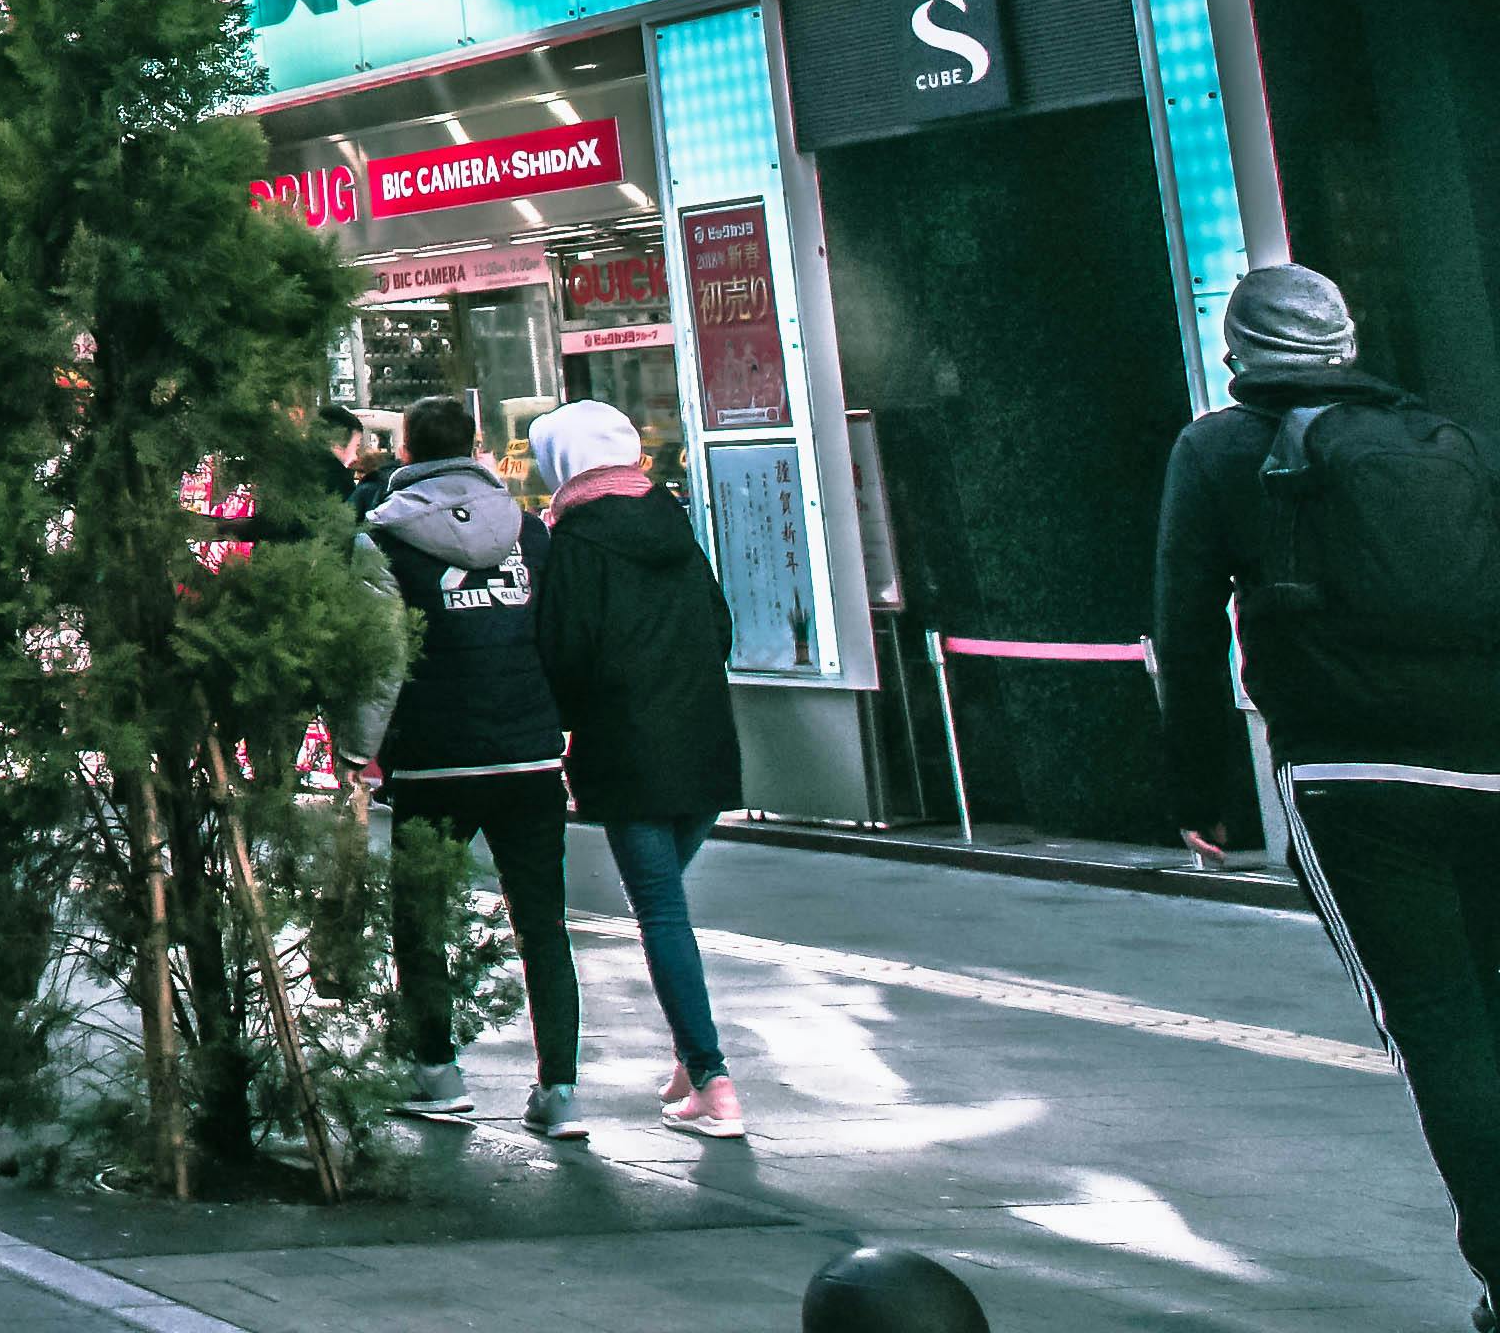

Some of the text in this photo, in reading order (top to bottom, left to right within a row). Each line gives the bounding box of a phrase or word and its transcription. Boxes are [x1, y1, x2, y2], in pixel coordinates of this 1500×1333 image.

[915, 67, 964, 90] CUBE
[381, 170, 414, 201] BIC
[416, 155, 501, 195] CAMERA
[511, 137, 602, 179] SHIDAX
[392, 271, 413, 290] BIC
[414, 263, 467, 287] CAMERA
[698, 275, 768, 325] 初売り
